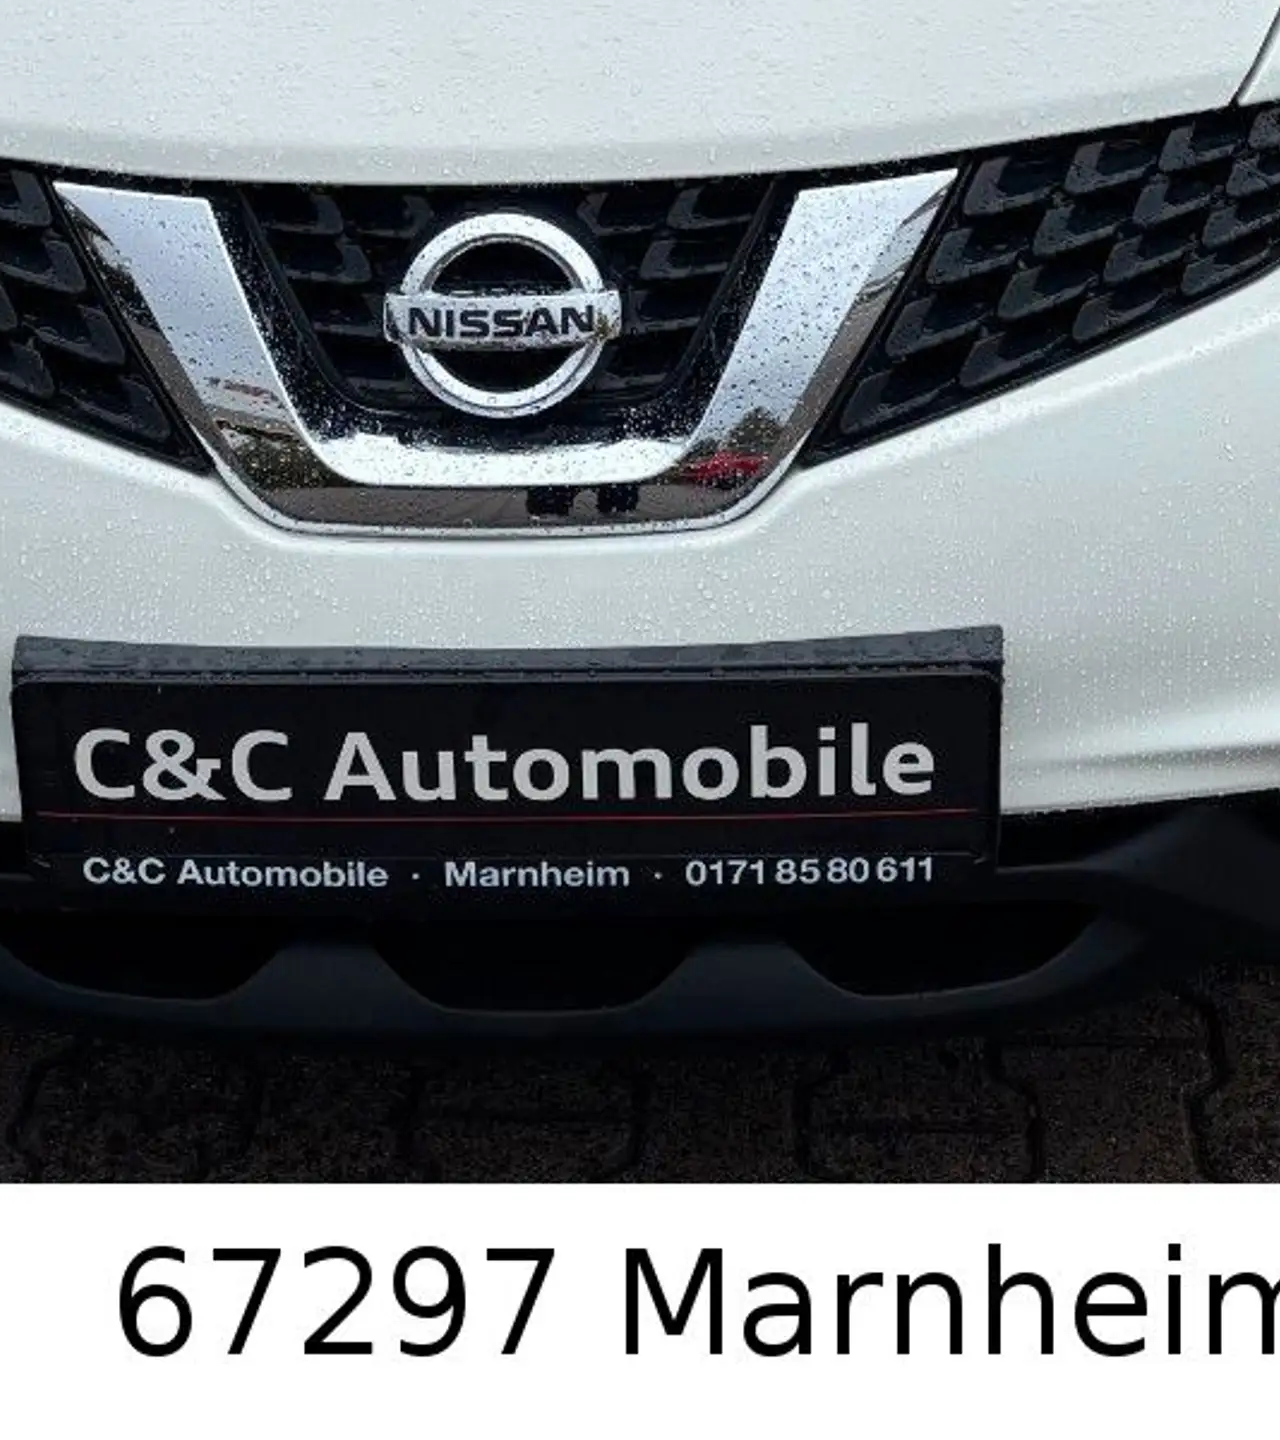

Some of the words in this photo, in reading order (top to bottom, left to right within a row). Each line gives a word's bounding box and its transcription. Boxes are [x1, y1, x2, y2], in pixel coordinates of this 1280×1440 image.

[408, 305, 594, 340] NISSAN
[74, 727, 293, 803] C&C
[323, 722, 935, 803] Automobile
[82, 856, 166, 886] C&C
[176, 858, 389, 888] Automobile
[444, 860, 631, 888] Marnheim
